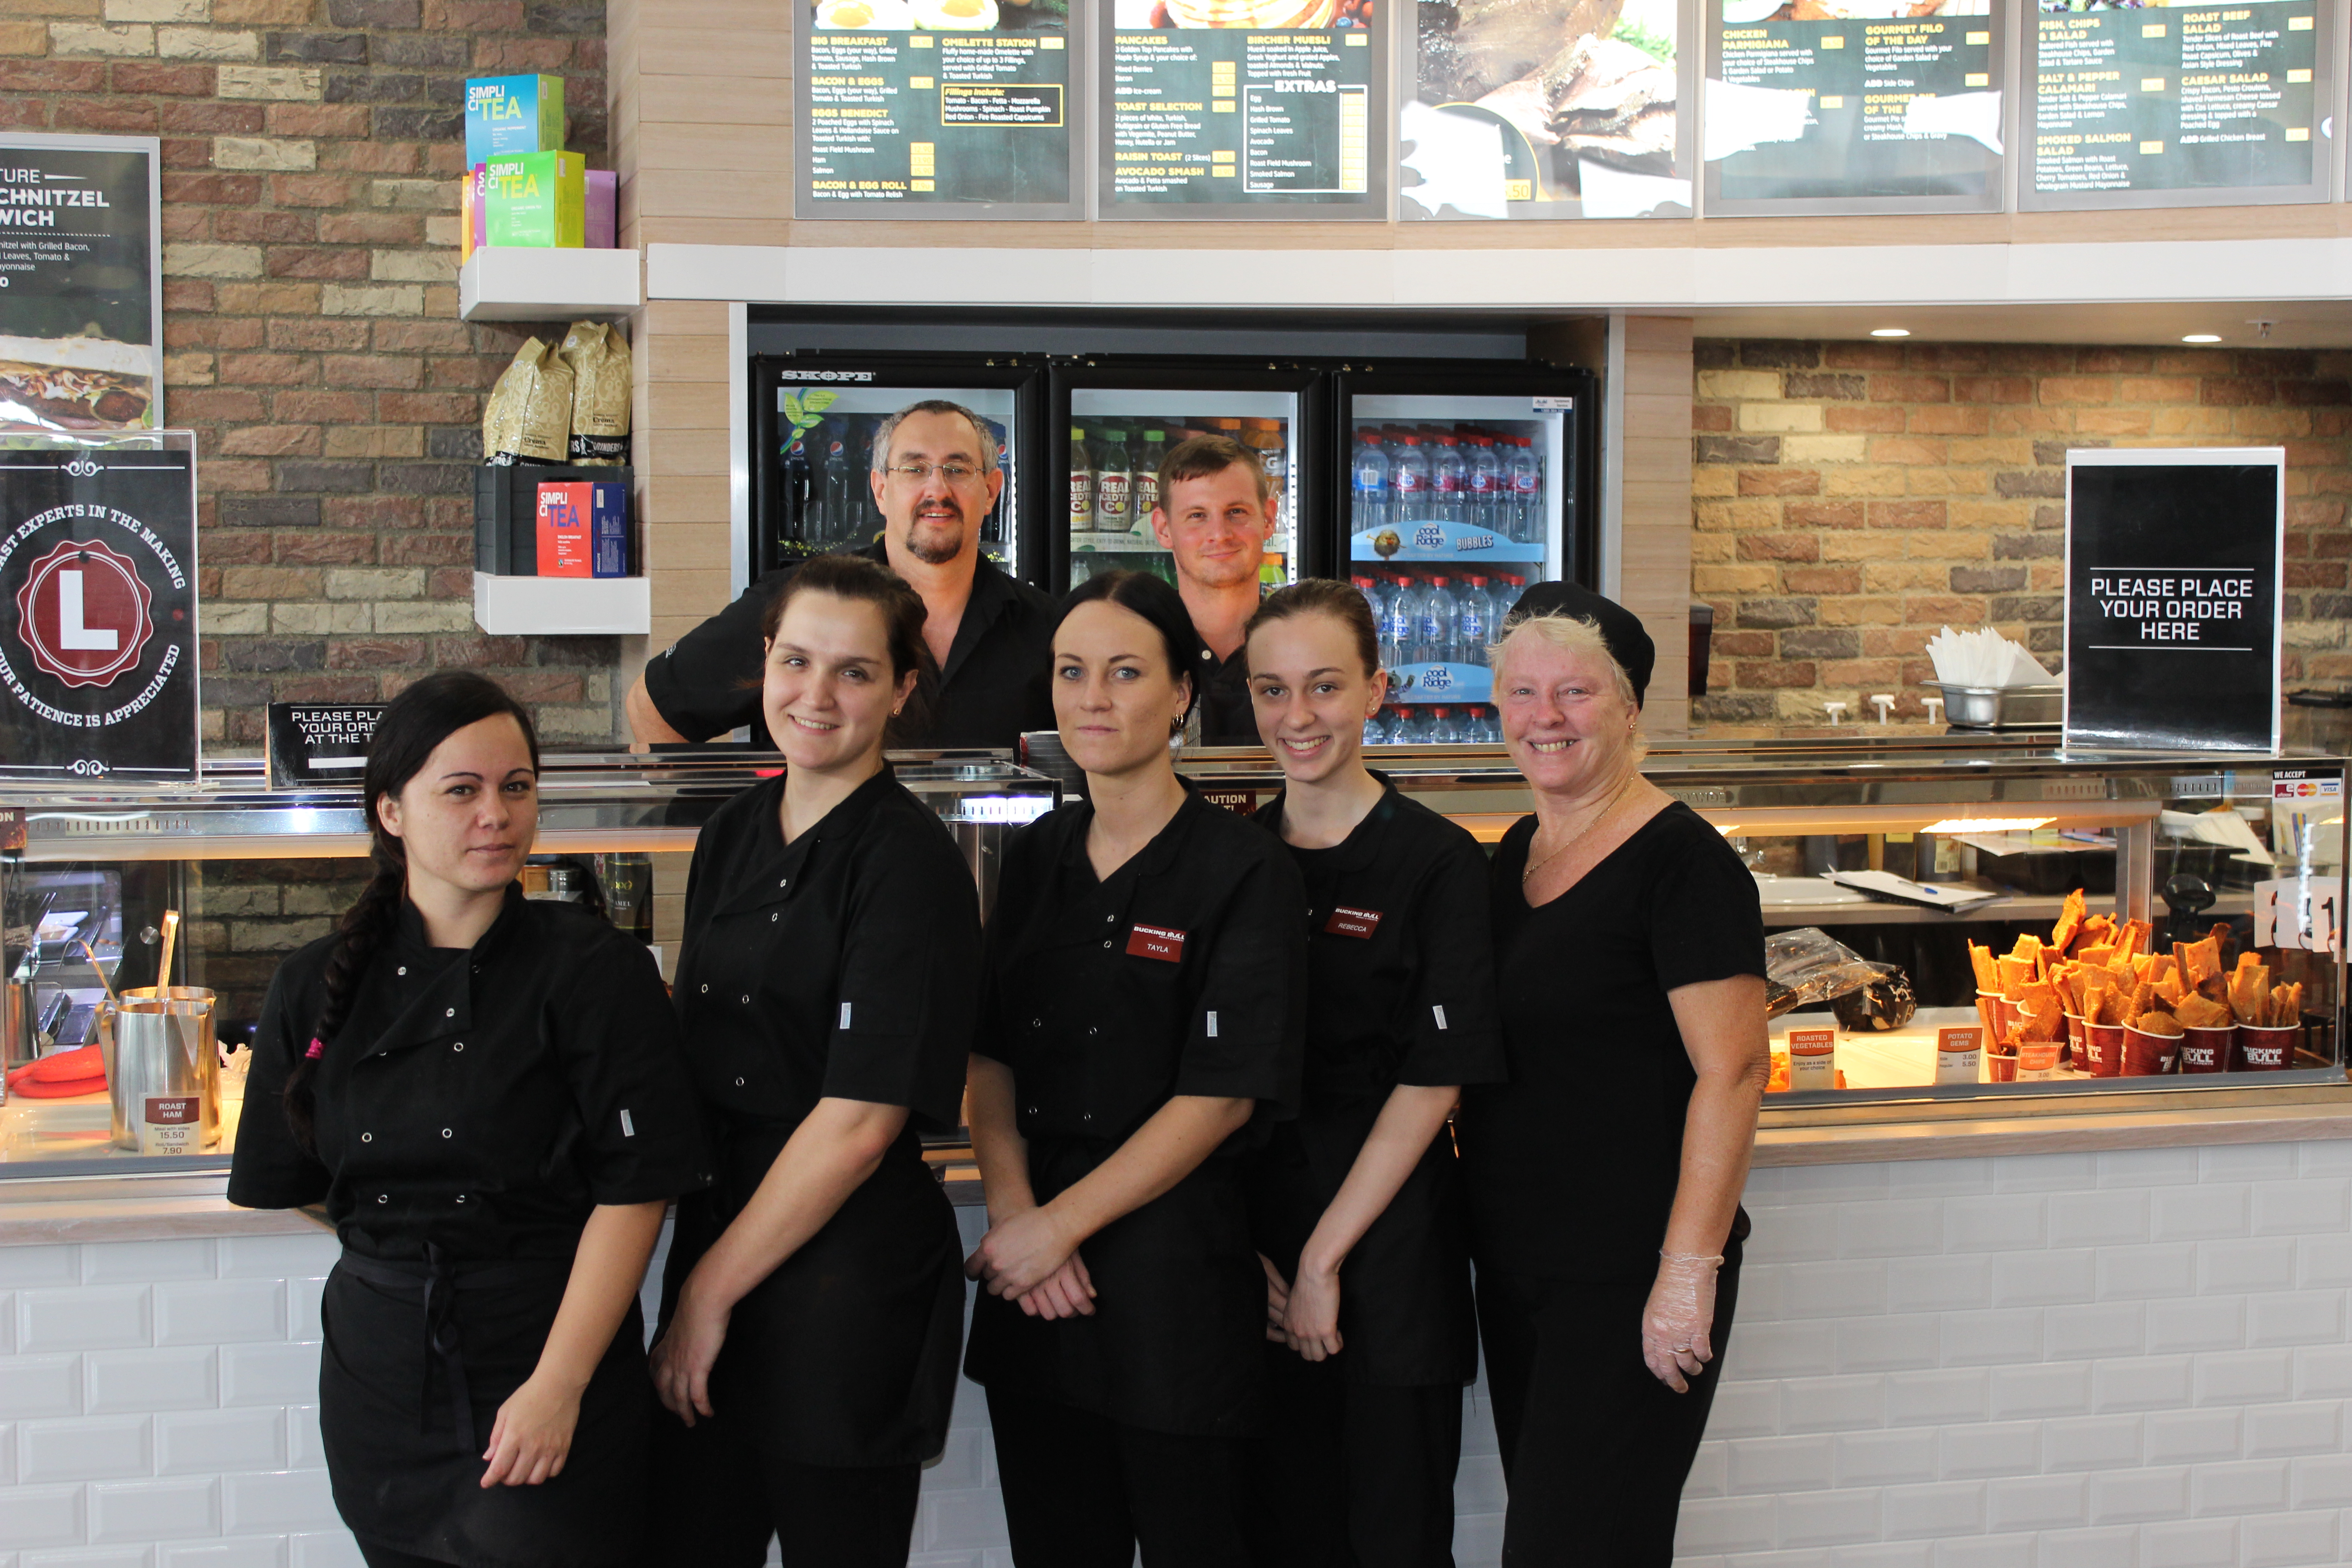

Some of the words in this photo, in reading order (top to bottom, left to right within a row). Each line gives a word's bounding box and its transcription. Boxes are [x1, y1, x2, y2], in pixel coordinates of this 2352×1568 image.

[2183, 12, 2220, 23] ROAST
[2223, 10, 2251, 21] BEEF
[1865, 24, 1917, 35] GOURMET
[1920, 24, 1944, 34] FILO
[2039, 20, 2066, 31] FISH,
[2068, 18, 2100, 29] CHIPS
[2183, 24, 2221, 34] SALAD
[1723, 29, 1767, 39] CHICKEN
[2051, 30, 2087, 41] SALAD
[811, 36, 828, 46] BIG
[831, 36, 888, 46] BREAKFAST
[942, 38, 994, 48] OMELETTE
[996, 38, 1036, 48] STATION
[1115, 36, 1168, 45] PANCAKES
[1247, 36, 1290, 45] BIRCHER
[1294, 36, 1331, 44] MUESLI
[1723, 39, 1788, 49] PARMIGIANA
[1865, 36, 1880, 45] OF
[1883, 35, 1903, 45] THE
[1907, 35, 1928, 44] DAY
[811, 77, 846, 86] BACON
[848, 77, 856, 86] &
[858, 77, 884, 86] EGGS
[1865, 79, 1883, 88] ADD
[1884, 79, 1896, 88] Side
[1897, 78, 1914, 88] Chips
[2038, 74, 2065, 84] SALT
[2078, 71, 2120, 82] PEPPER
[2181, 75, 2227, 86] CAESAR
[2230, 73, 2269, 83] SALAD
[469, 85, 505, 100] SIMPLI
[946, 88, 973, 97] Fillings
[974, 88, 1004, 97] Include:
[1274, 81, 1337, 93] EXTRAS
[2038, 84, 2096, 95] CALAMARI
[1115, 103, 1147, 112] TOAST
[1150, 103, 1203, 112] SELECTION
[1864, 105, 1879, 114] OF
[1882, 105, 1903, 114] THE
[812, 109, 838, 118] EGGS
[841, 109, 888, 118] BENEDICT
[2037, 134, 2082, 145] SMOKED
[2085, 132, 2131, 144] SALMON
[1115, 153, 1148, 162] RAISIN
[1151, 152, 1182, 162] TOAST
[2037, 146, 2074, 157] SALAD
[489, 162, 524, 177] SIMPLI
[1115, 167, 1166, 176] AVOCADO
[1168, 168, 1205, 176] SMASH
[812, 181, 847, 190] BACON
[849, 181, 857, 190] &
[859, 181, 879, 190] EGG
[881, 181, 907, 190] ROLL
[20, 242, 36, 250] with
[39, 242, 63, 250] Grilled
[64, 243, 90, 252] Bacon,
[4, 251, 31, 261] Leaves,
[34, 252, 62, 261] Tomato
[782, 370, 872, 382] SKOPE
[524, 436, 546, 446] Crema
[1265, 456, 1277, 469] G
[1101, 481, 1130, 493] REAL
[540, 492, 568, 505] SIMPLI
[1419, 525, 1440, 535] cool
[1415, 534, 1444, 548] Ridge
[1456, 535, 1494, 551] BUBBLES
[16, 504, 85, 539] EXPERTS
[88, 504, 107, 519] IN
[110, 508, 142, 534] THE
[140, 526, 186, 590] MAKING
[2091, 578, 2175, 597] PLEASE
[2181, 579, 2253, 598] PLACE
[59, 570, 118, 650] L
[2100, 600, 2159, 617] YOUR
[2166, 601, 2242, 618] ORDER
[2141, 622, 2200, 640] HERE
[1426, 667, 1447, 677] cool
[0, 646, 16, 686] OUR
[12, 683, 83, 727] PATIENCE
[86, 715, 101, 727] IS
[104, 644, 180, 726] APPRECIATED
[1422, 677, 1451, 690] Ridge
[292, 711, 352, 722] PLEASE
[299, 723, 343, 733] YOUR
[304, 734, 324, 745] AT
[328, 733, 360, 744] THE
[2284, 770, 2306, 779] ACCEPT
[1335, 908, 1362, 917] BUCKING
[1363, 911, 1379, 920] BULL
[1134, 926, 1166, 937] BUCKING
[1166, 931, 1185, 941] BULL
[1338, 923, 1367, 933] REBECCA
[1147, 943, 1169, 953] TAYLA
[2243, 1046, 2282, 1054] BUCKING
[2247, 1052, 2281, 1062] BULL
